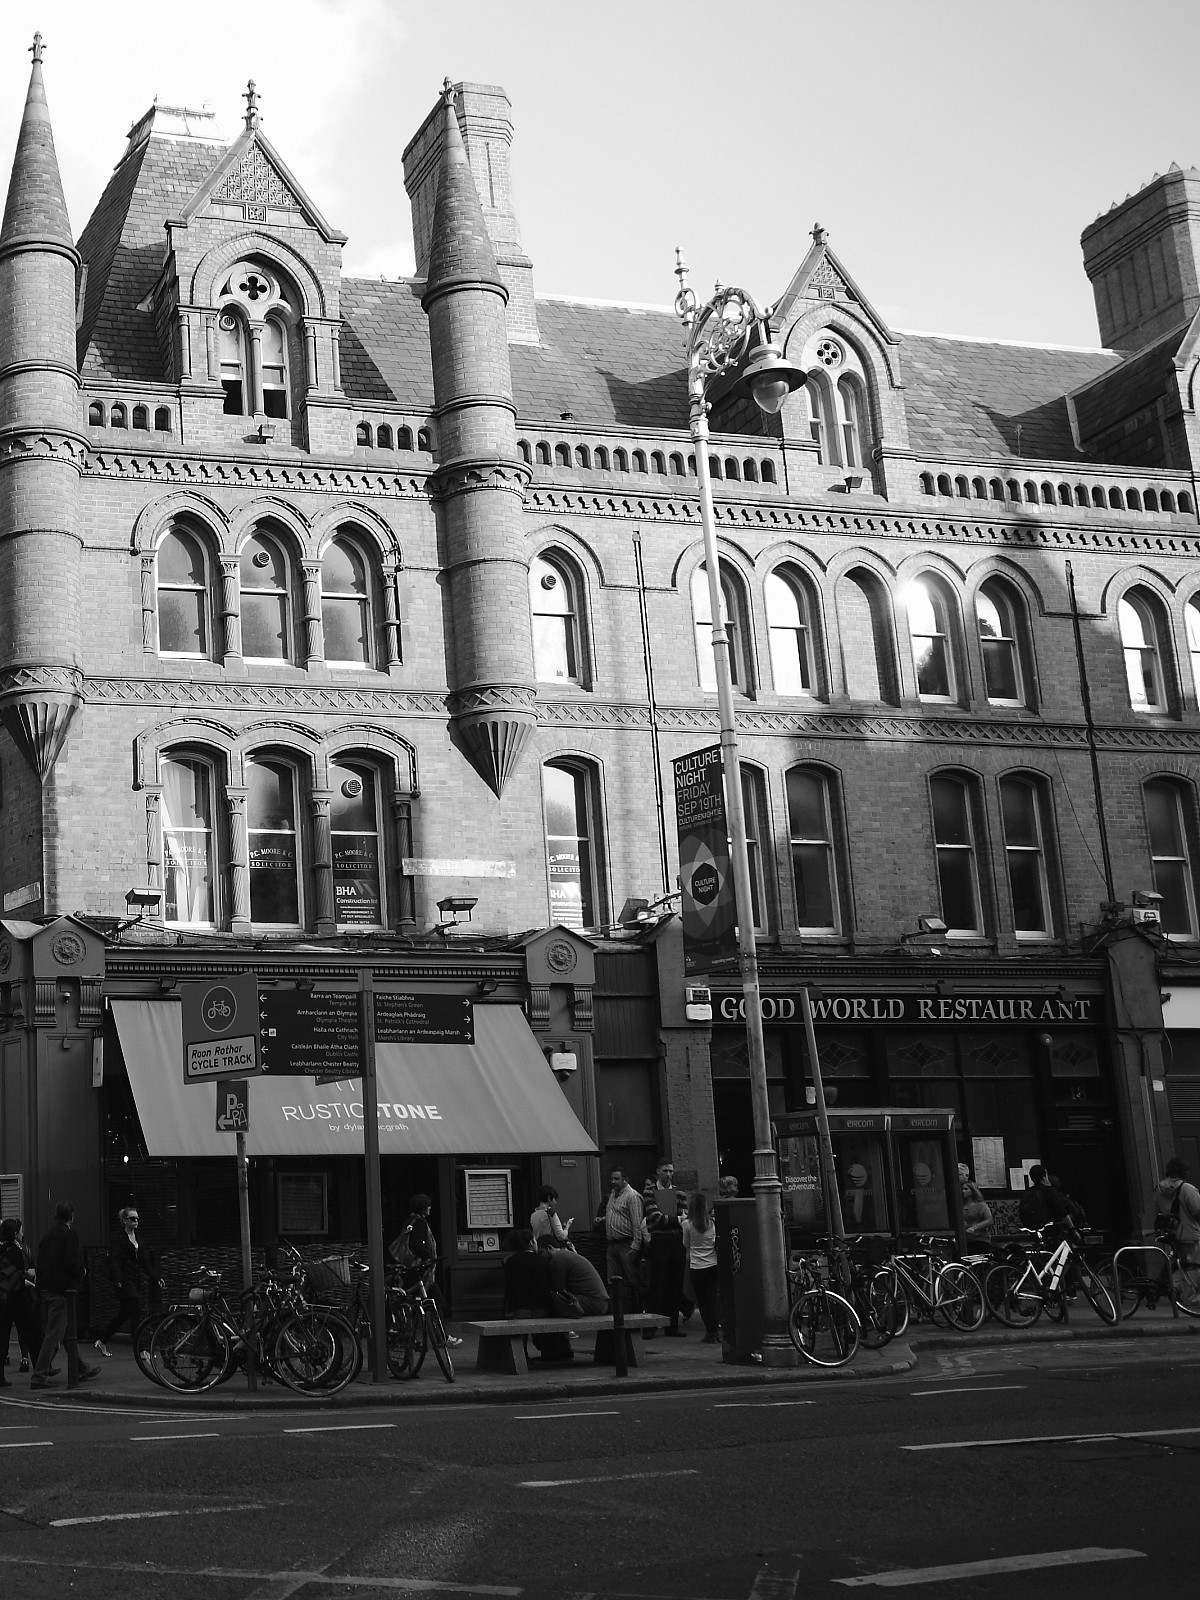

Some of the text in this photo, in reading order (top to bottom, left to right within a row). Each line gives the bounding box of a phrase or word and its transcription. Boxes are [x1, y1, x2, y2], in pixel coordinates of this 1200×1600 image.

[675, 749, 719, 775] CULTURE
[676, 768, 706, 789] NIGHT
[677, 781, 711, 802] FRIDAY
[677, 793, 722, 817] SEP 19TH
[694, 876, 716, 887] CULTURE
[698, 885, 714, 893] NIGHT
[336, 886, 357, 896] BHA
[720, 996, 1091, 1022] GOD WORLD RESTAURANT
[214, 1044, 243, 1056] Rothar
[191, 1053, 253, 1071] CYCLE TRACK
[226, 1093, 238, 1119] P
[281, 1102, 443, 1121] RUSTICTONE
[329, 1123, 409, 1132] by dyla cgrath
[846, 1119, 874, 1128] eircom
[910, 1118, 938, 1127] eircom
[785, 1175, 817, 1184] Discover the
